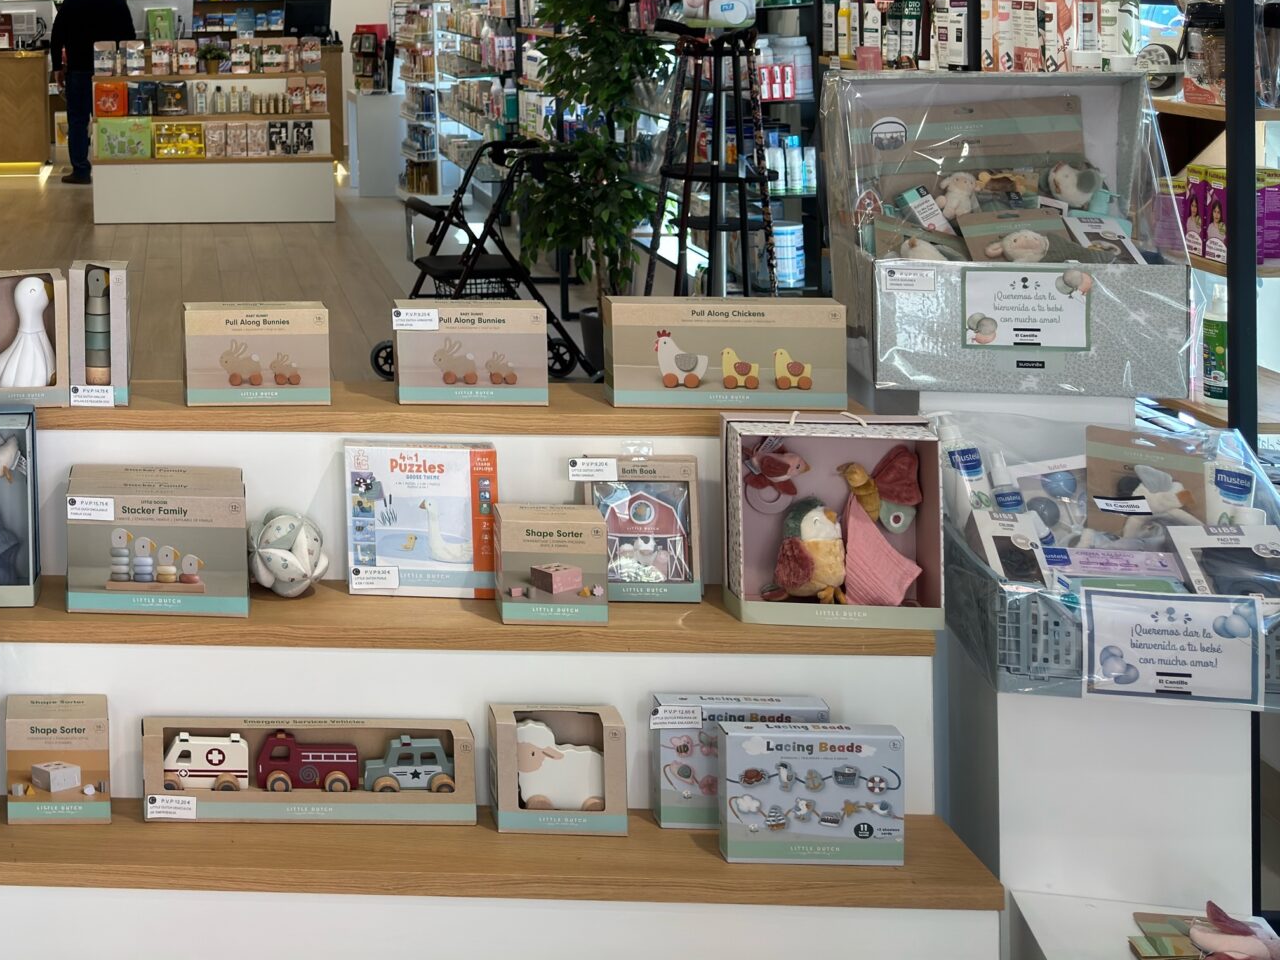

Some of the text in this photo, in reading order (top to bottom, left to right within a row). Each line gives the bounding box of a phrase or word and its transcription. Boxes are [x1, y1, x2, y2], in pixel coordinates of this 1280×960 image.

[994, 292, 1057, 301] ¡Queremos dar la
[993, 303, 1029, 312] bienvenida
[1047, 303, 1064, 312] bebé
[707, 310, 729, 318] Along
[1015, 315, 1037, 323] mucho
[1039, 315, 1061, 323] amor!
[240, 319, 260, 327] Along
[454, 317, 476, 325] Along
[399, 453, 406, 461] 4
[414, 453, 419, 461] 1
[389, 458, 445, 474] Puzzles
[1217, 473, 1251, 488] mustela
[997, 494, 1021, 502] mustela
[121, 505, 188, 517] Stacker Family
[525, 529, 583, 539] Shape Sorter
[1045, 552, 1068, 560] ustela
[1131, 624, 1213, 639] ¡Queremos dar la
[1130, 639, 1177, 651] bienvenida
[1187, 642, 1198, 652] tu
[1200, 642, 1223, 653] bebé
[1139, 656, 1218, 668] con mucho amor!
[702, 712, 745, 722] Lacing
[750, 712, 792, 722] Beads
[29, 726, 86, 736] Shape Sorter
[766, 741, 863, 755] Lacing Beads
